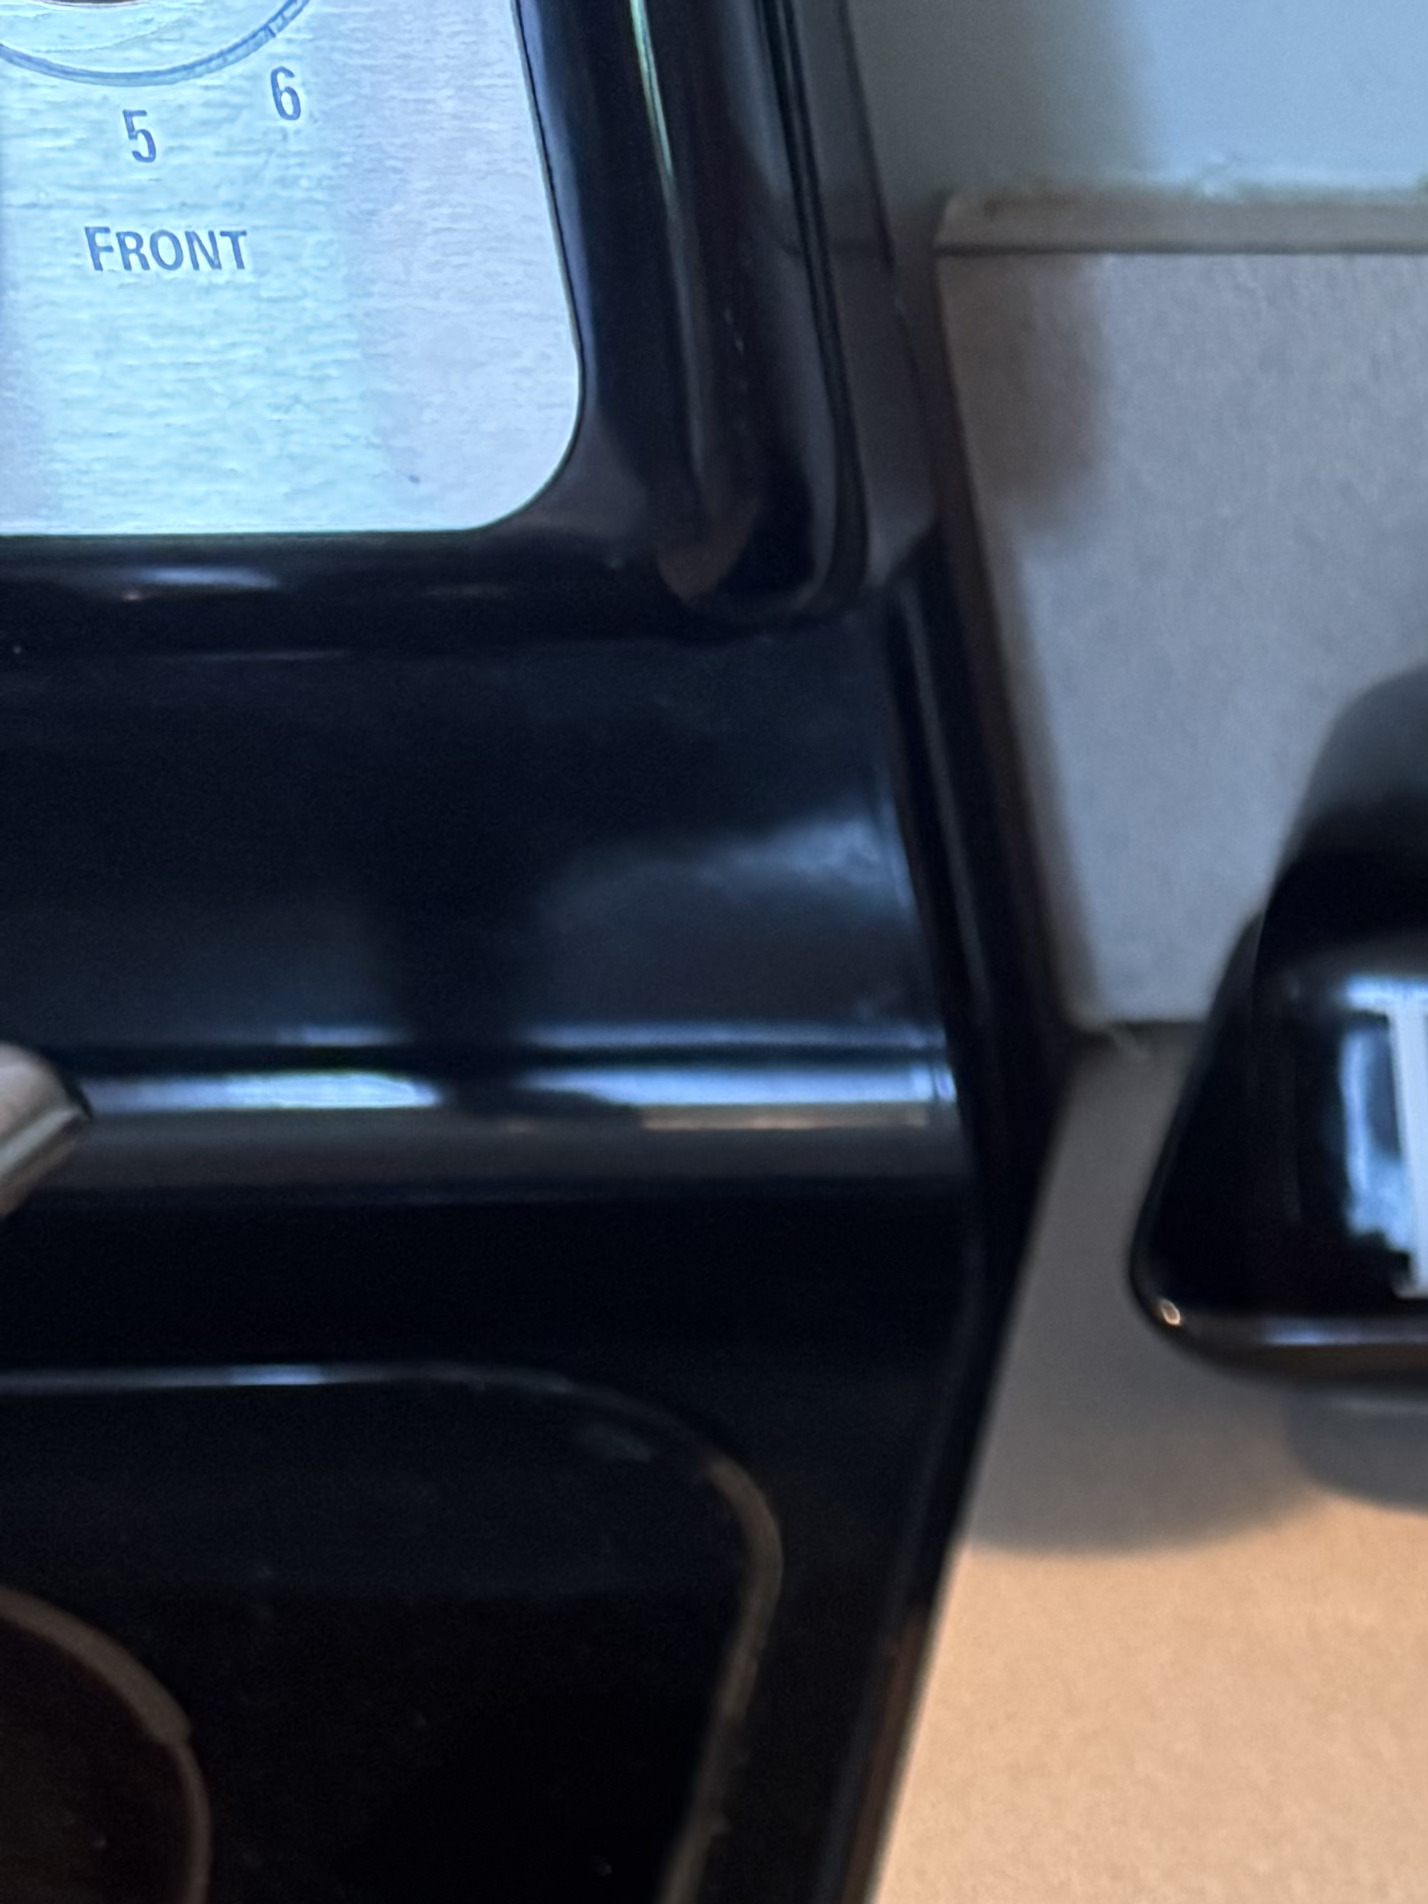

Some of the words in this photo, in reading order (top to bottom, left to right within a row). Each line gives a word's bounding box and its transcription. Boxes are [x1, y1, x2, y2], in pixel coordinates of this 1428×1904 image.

[269, 65, 302, 122] 6
[122, 109, 157, 163] 5
[84, 226, 248, 272] FRONT
